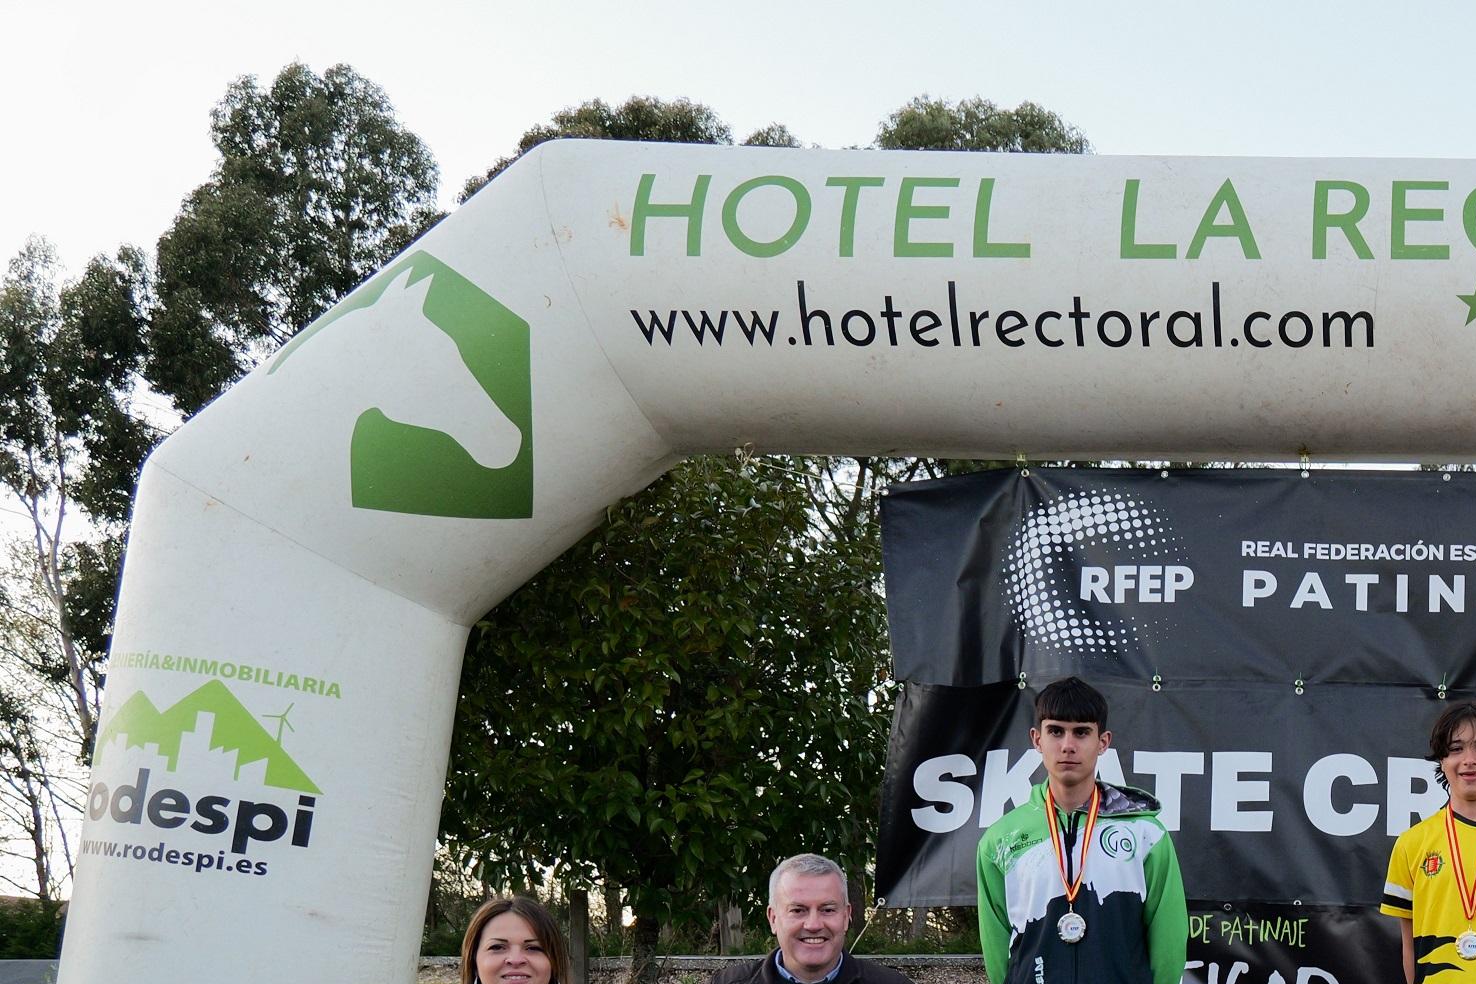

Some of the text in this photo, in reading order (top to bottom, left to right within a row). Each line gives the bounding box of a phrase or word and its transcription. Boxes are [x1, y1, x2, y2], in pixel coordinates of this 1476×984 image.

[630, 173, 1031, 258] HOTEL
[1119, 177, 1262, 260] LA
[630, 280, 1374, 348] www.hotelrectoral.com
[1241, 540, 1299, 559] REAL
[1303, 540, 1444, 561] FEDERACIÓN
[1080, 565, 1194, 603] RFEP
[88, 768, 316, 855] odespi
[83, 839, 268, 876] www.rodespi.es
[1189, 913, 1309, 947] DE PATINAJE
